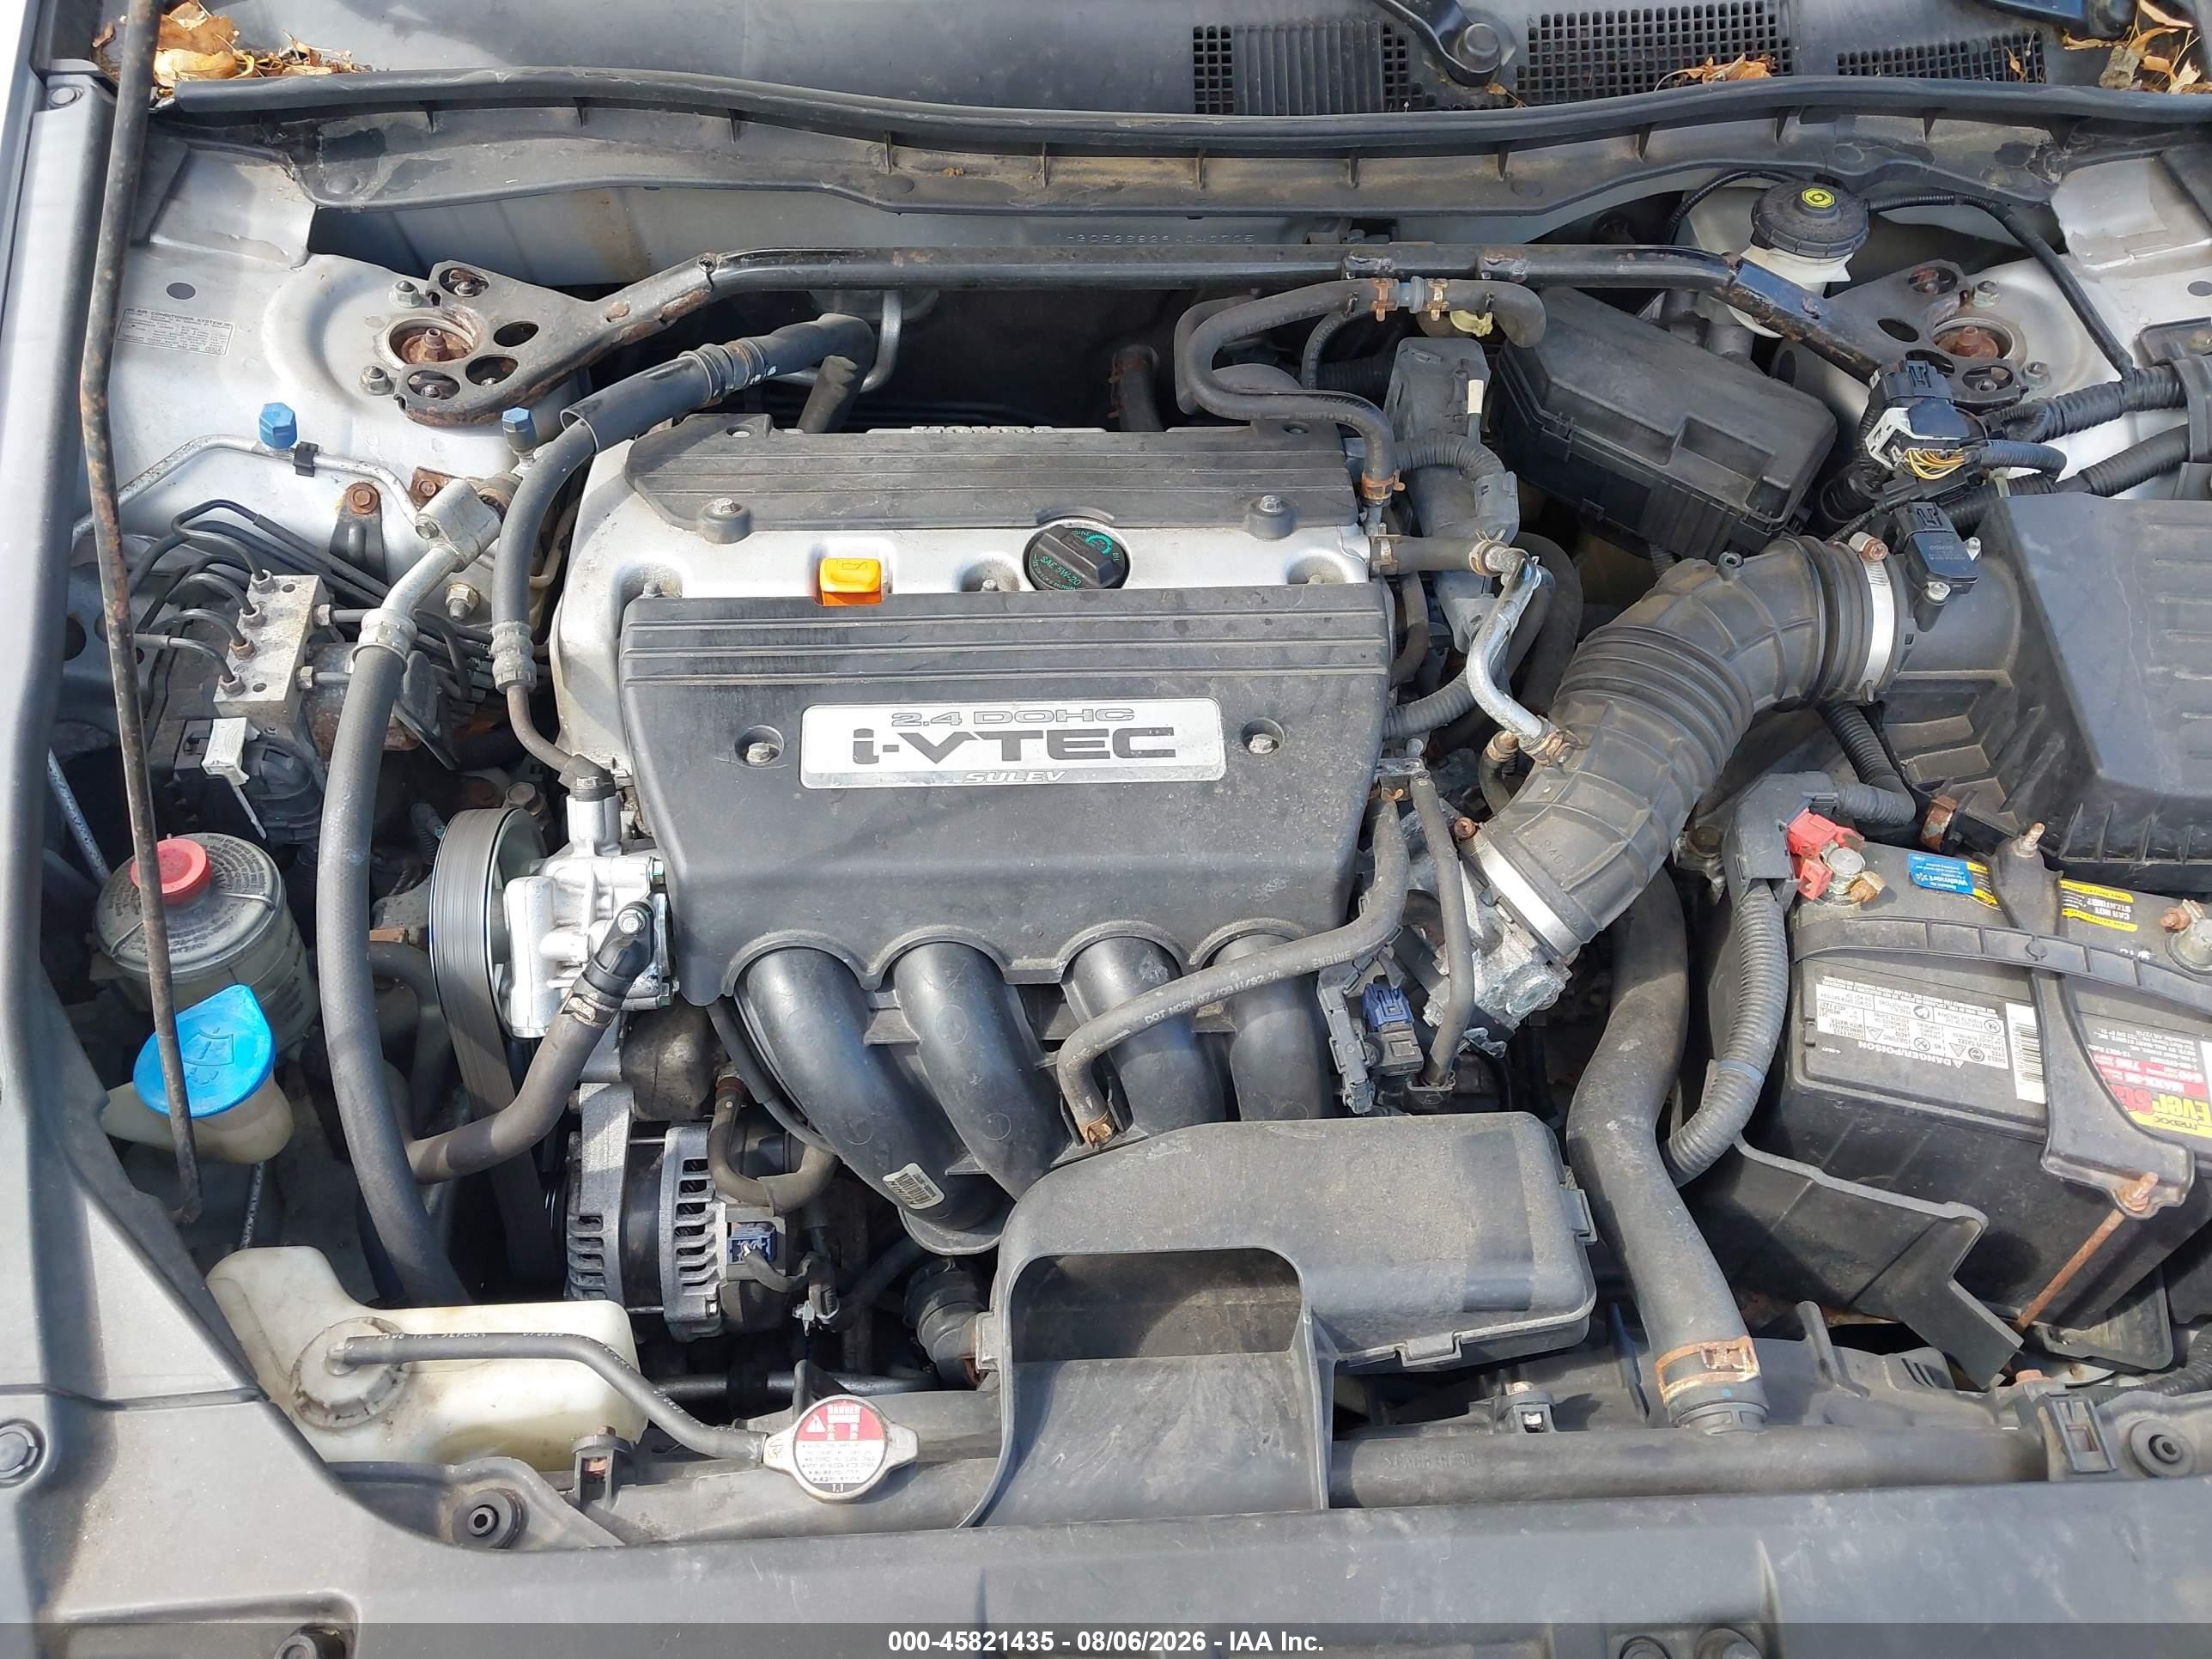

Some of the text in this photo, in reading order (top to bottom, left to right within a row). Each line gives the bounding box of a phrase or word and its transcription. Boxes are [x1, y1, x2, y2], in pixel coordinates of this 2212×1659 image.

[1040, 556, 1058, 568] SAE
[1056, 566, 1082, 586] 5W-20
[891, 708, 1134, 726] 2.4 DOHC
[853, 726, 1176, 764] i-VTEC
[963, 769, 1067, 783] SULEV
[1929, 874, 1968, 886] Walmart
[2112, 909, 2130, 921] CAR
[1144, 1010, 1166, 1025] DOT
[1857, 1041, 1952, 1066] DANGER/POISON
